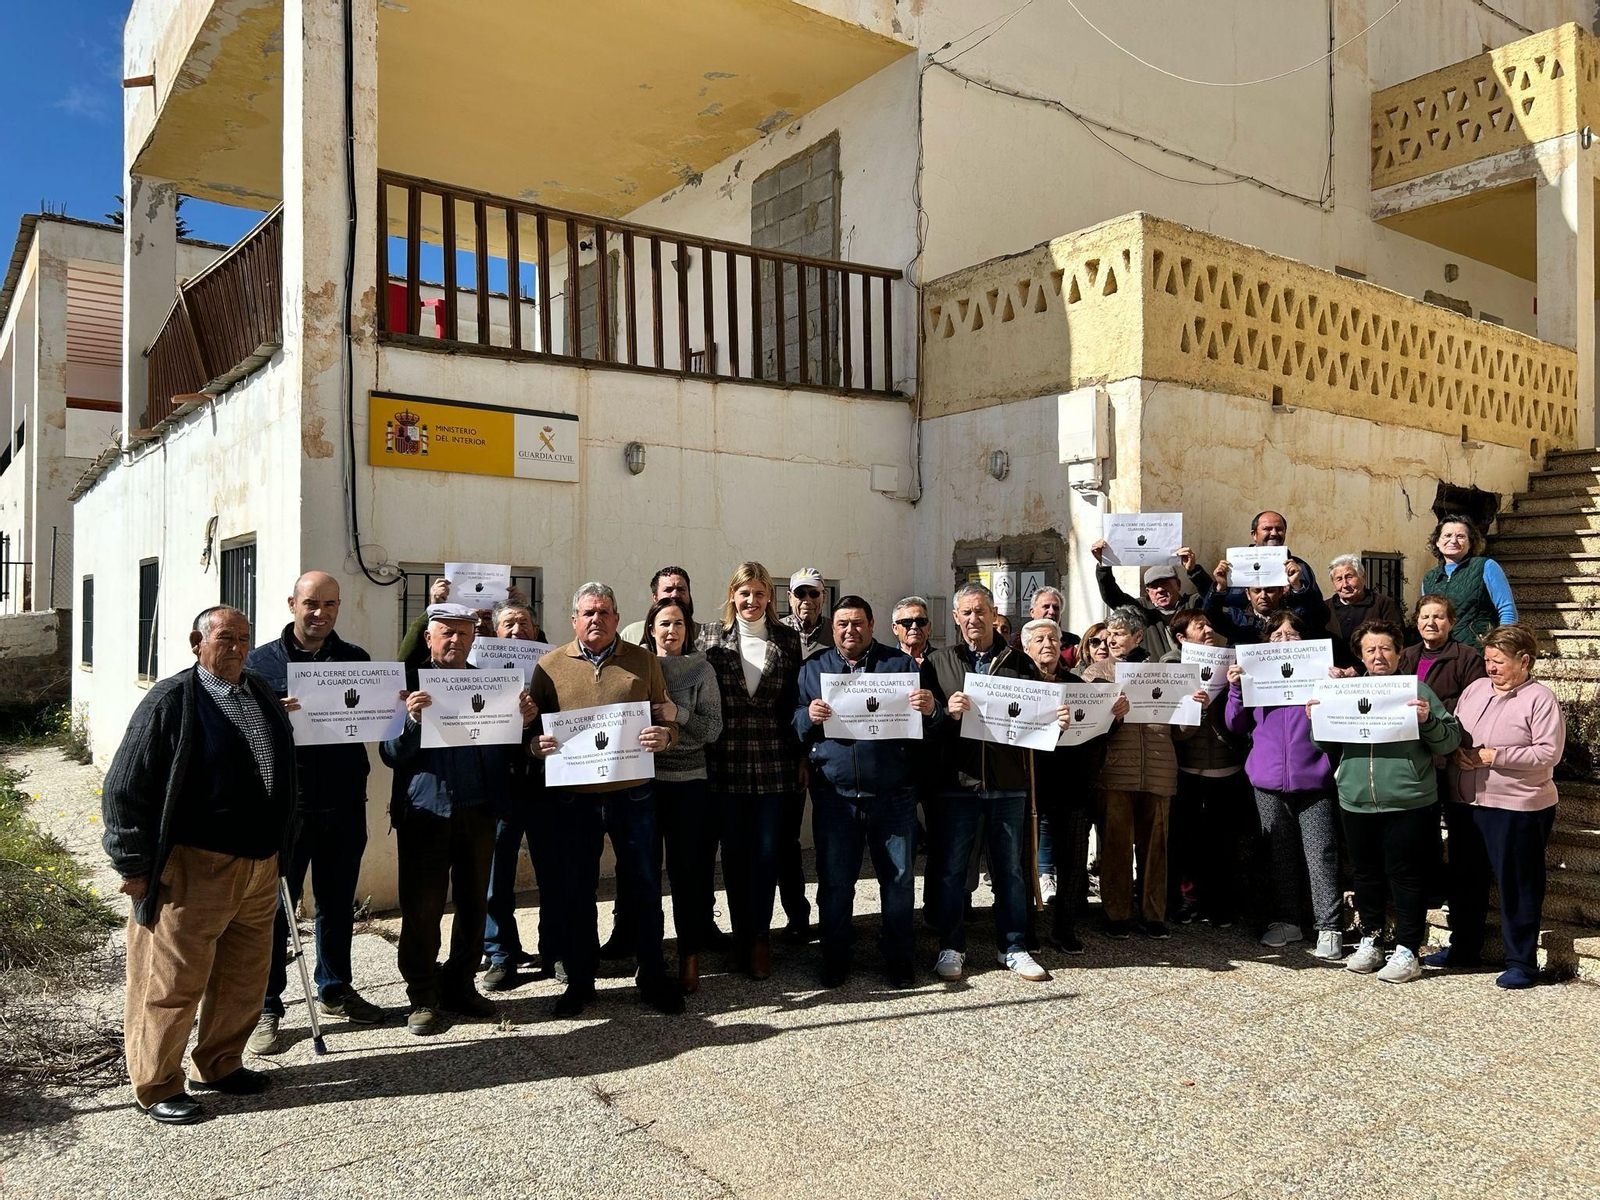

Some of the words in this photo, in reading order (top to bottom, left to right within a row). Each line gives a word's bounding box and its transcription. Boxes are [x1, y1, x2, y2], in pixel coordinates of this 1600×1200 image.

[436, 425, 477, 436] MINISTERIO
[452, 436, 486, 445] INTERIOR
[518, 450, 553, 460] GUARDIA
[993, 683, 1012, 691] CIERRE
[1026, 687, 1051, 696] CUARTEL
[574, 715, 595, 724] CIERRE
[609, 710, 636, 719] CUARTEL
[578, 721, 607, 731] GUARDIA
